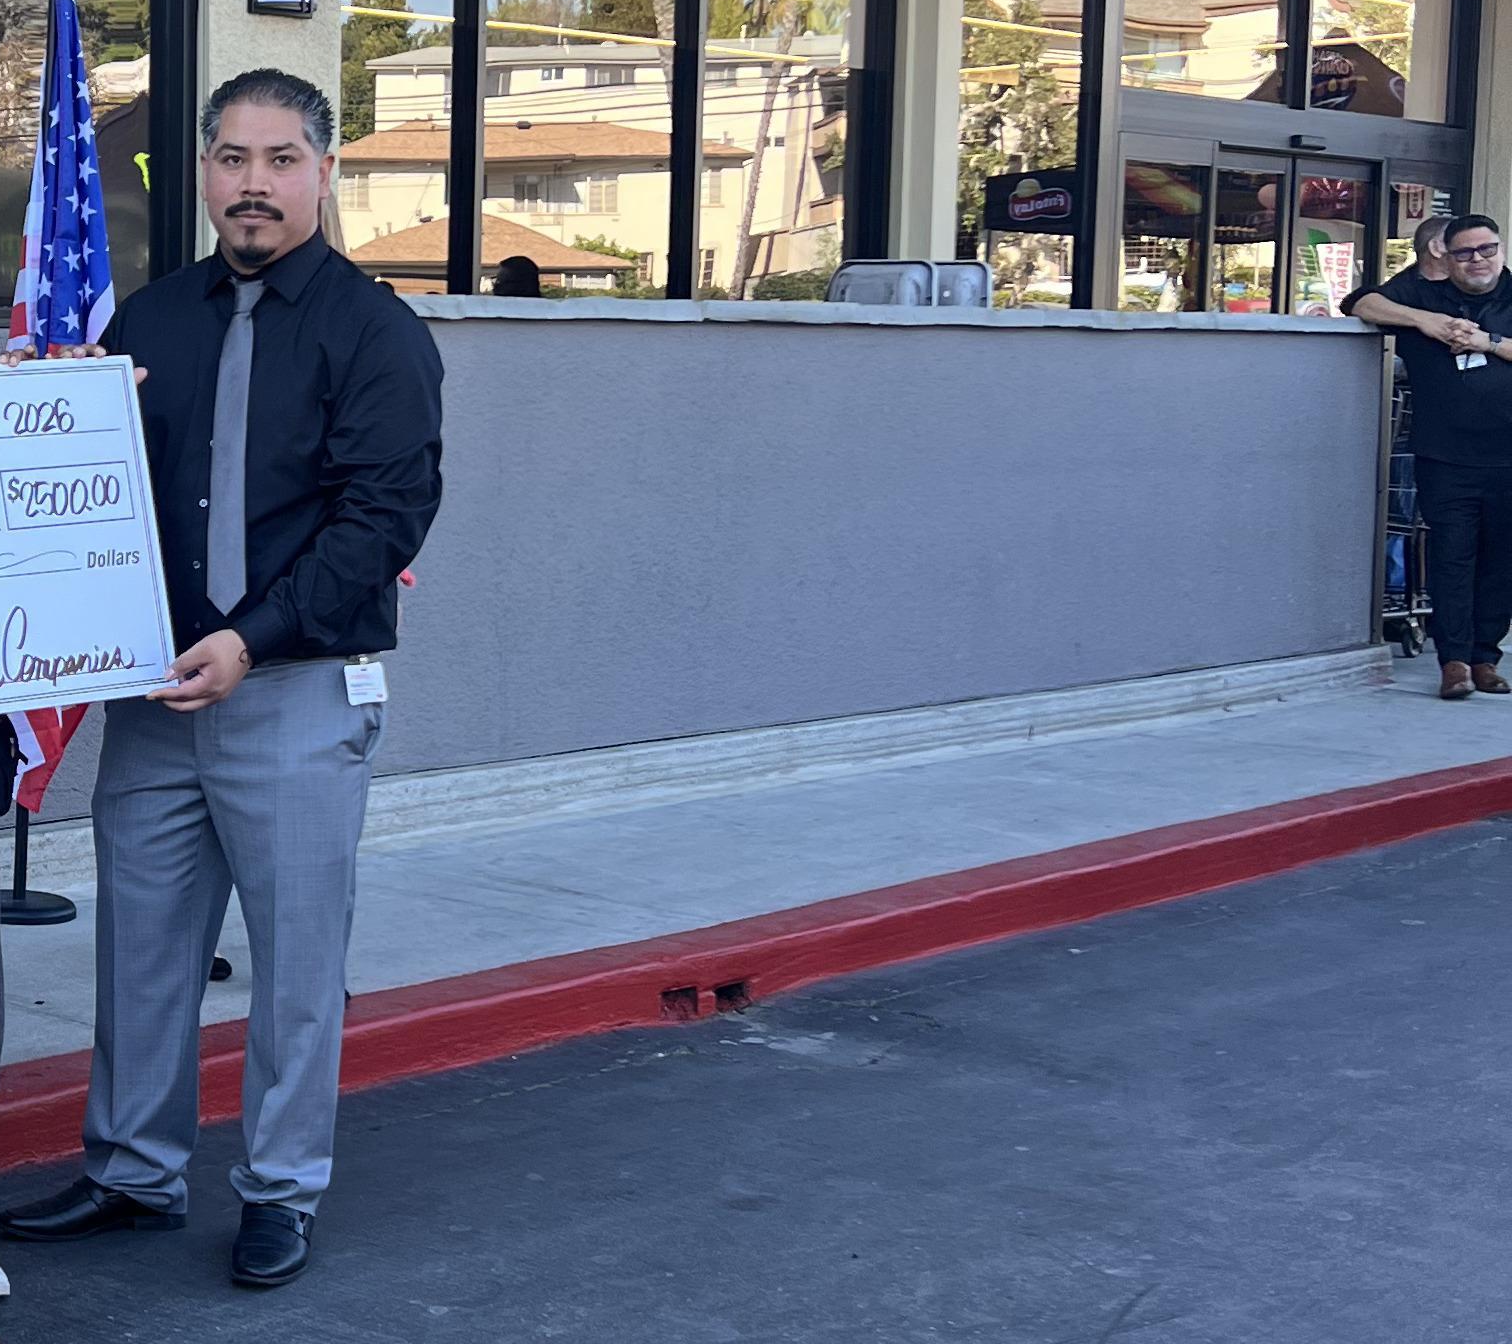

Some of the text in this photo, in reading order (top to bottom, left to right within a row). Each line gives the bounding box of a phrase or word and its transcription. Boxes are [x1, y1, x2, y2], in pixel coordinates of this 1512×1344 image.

[3, 397, 75, 435] 2026
[7, 473, 120, 518] $2500.00
[87, 549, 140, 569] Dollars
[2, 605, 135, 687] Companies
